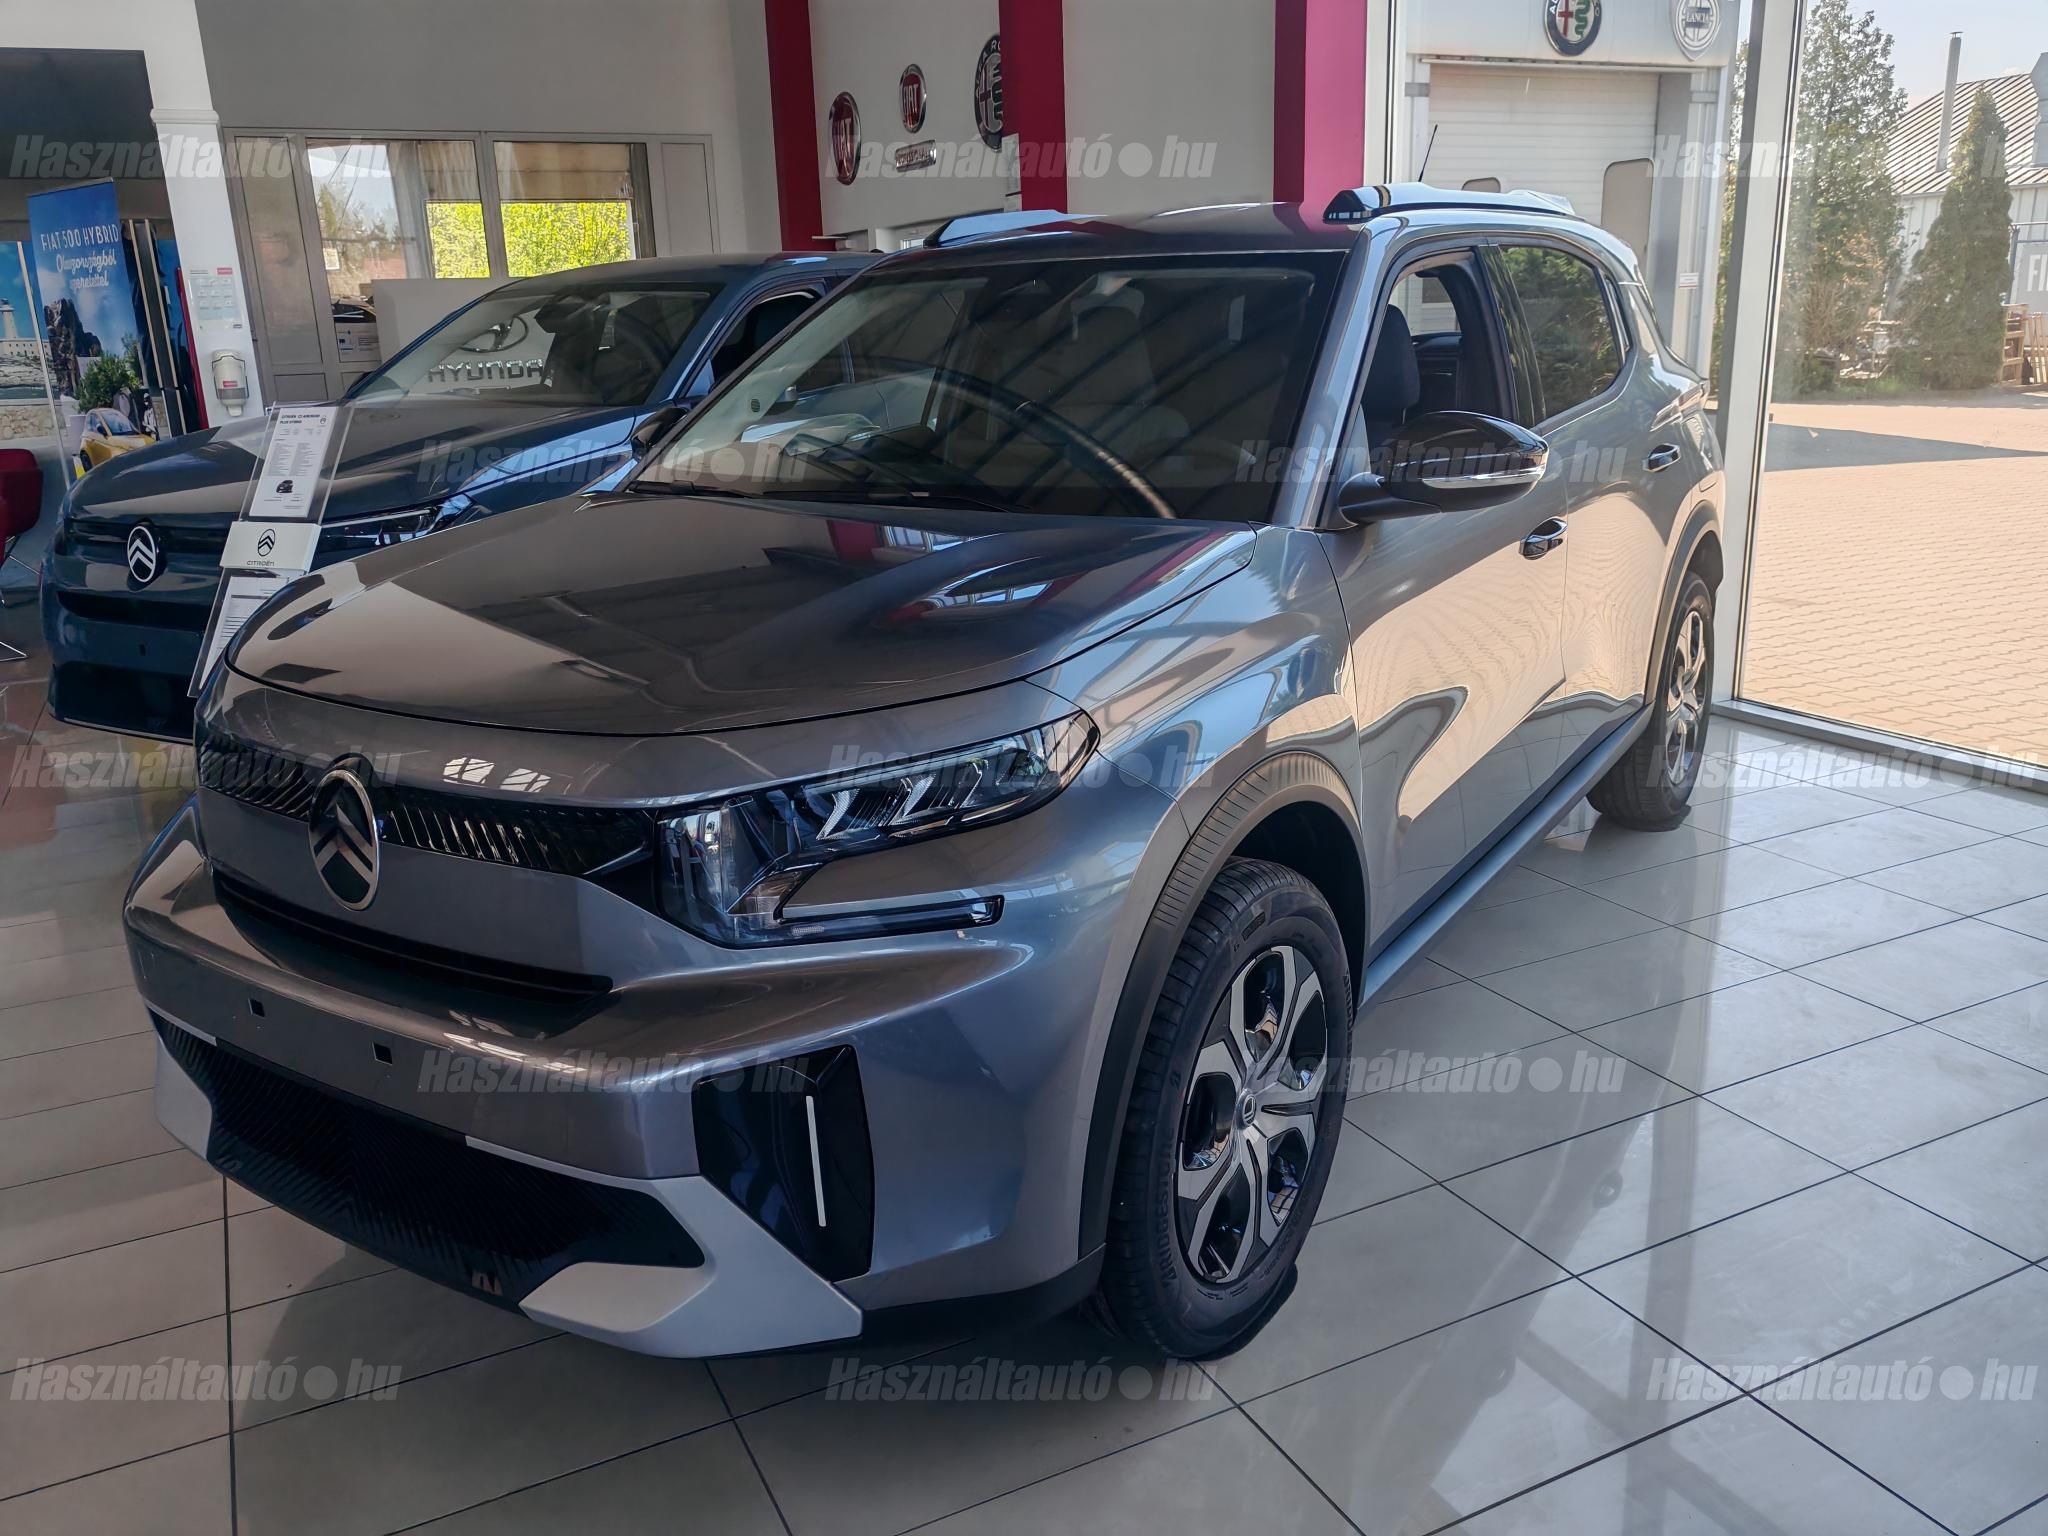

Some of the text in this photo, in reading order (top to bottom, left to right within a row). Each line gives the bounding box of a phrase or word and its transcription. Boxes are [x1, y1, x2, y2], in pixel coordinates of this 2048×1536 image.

[41, 224, 118, 251] FIAT 500 HYBRID
[56, 248, 117, 275] Olzországból
[2027, 254, 2048, 291] FI
[428, 358, 544, 383] HYUNDA
